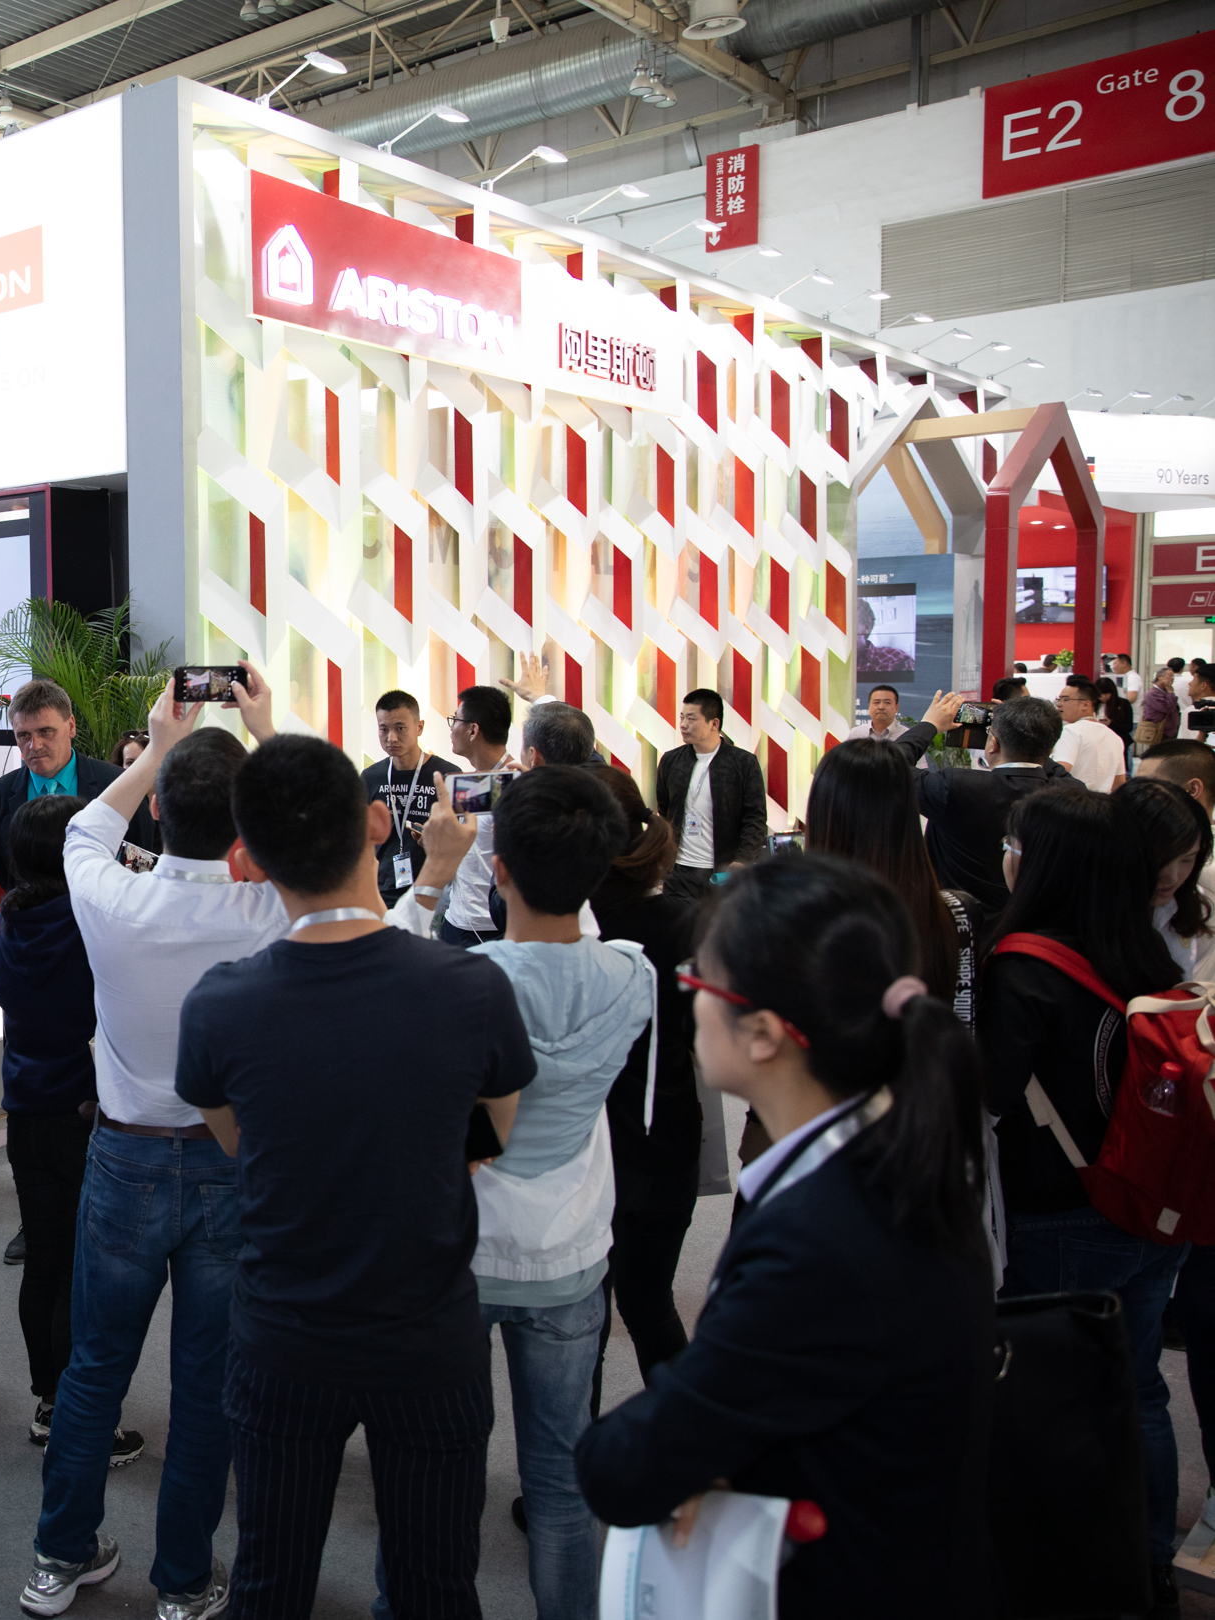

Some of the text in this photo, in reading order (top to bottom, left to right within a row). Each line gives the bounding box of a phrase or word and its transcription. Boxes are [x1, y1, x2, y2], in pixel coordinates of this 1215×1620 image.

[1096, 68, 1159, 95] Gate
[1165, 69, 1206, 122] 8
[1002, 100, 1083, 162] E2
[716, 157, 724, 217] FIRE HYDRANT
[727, 153, 746, 216] 消防栓
[326, 266, 515, 356] ARISTON
[558, 322, 657, 392] 阿里斯顿
[1157, 468, 1173, 484] 90
[1176, 469, 1210, 485] Years
[1196, 546, 1215, 571] E
[379, 784, 436, 795] ARMANI EANS
[416, 795, 428, 810] 81
[950, 907, 970, 933] LIFE
[955, 947, 971, 987] SHAPE
